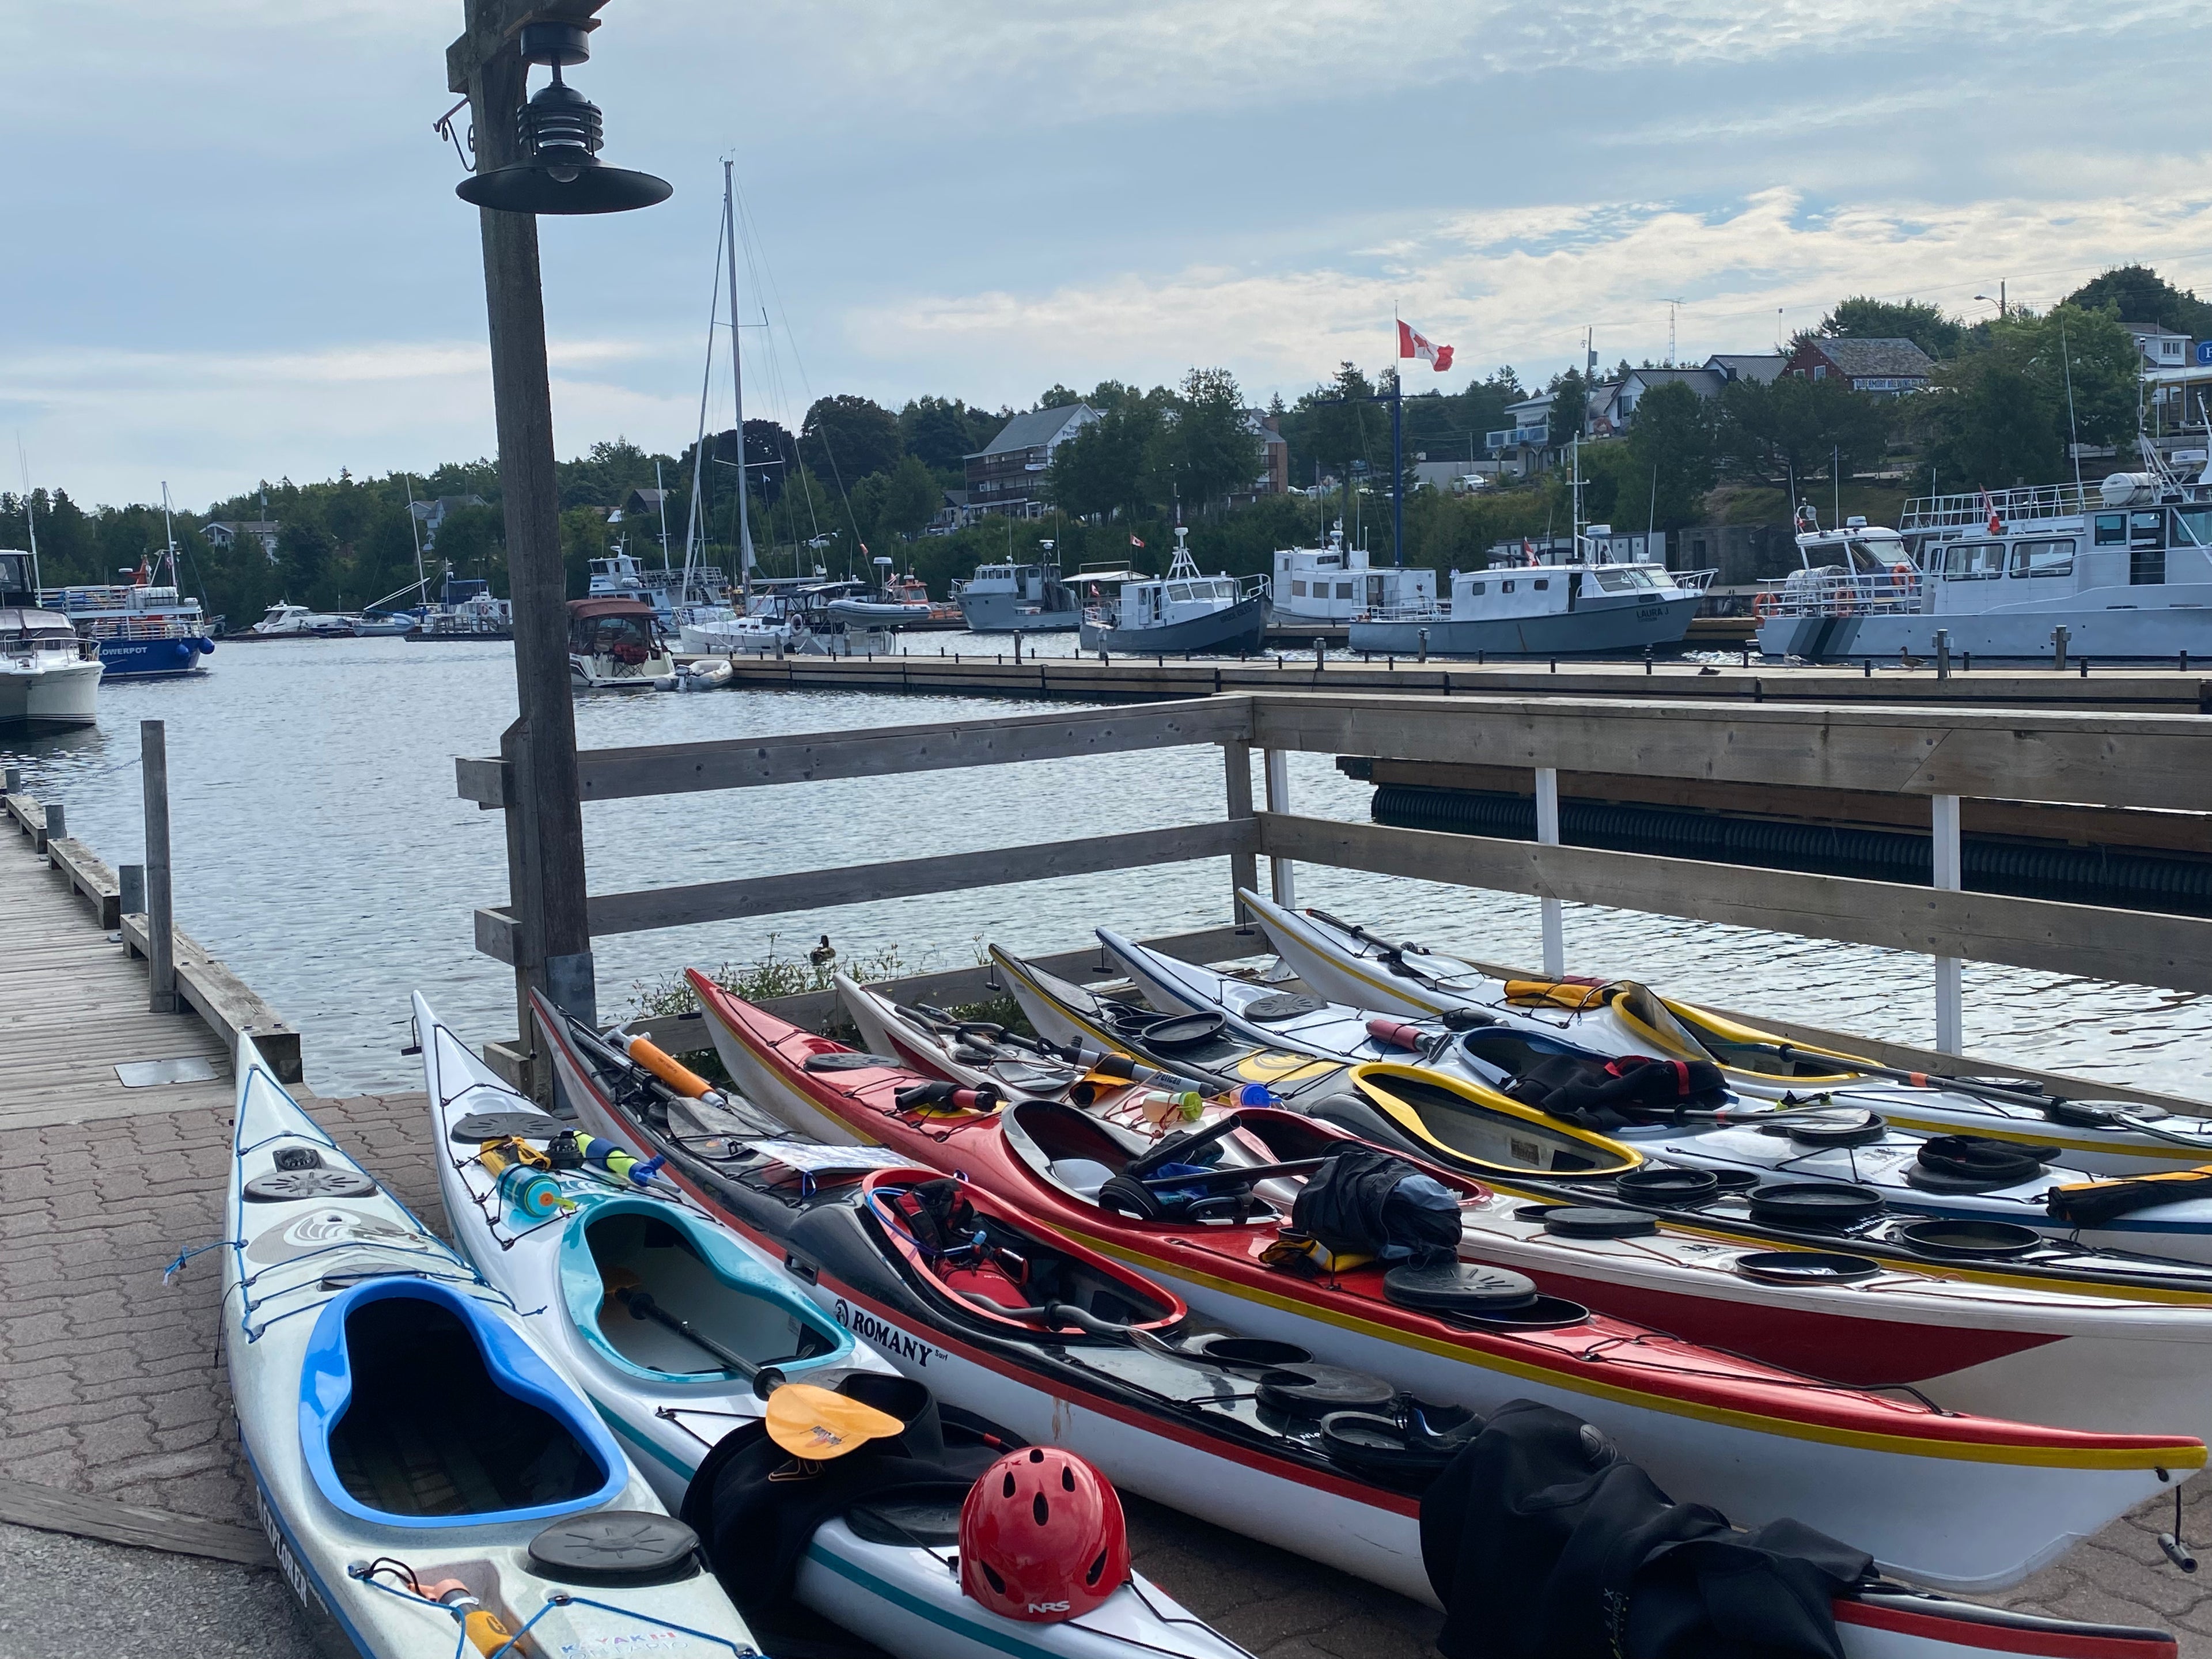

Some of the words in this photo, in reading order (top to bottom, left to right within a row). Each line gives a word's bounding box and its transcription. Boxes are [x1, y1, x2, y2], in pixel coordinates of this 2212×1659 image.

[1637, 608, 1663, 618] LAURA
[1665, 607, 1669, 615] J
[99, 647, 147, 656] OWERPOT
[1155, 1073, 1181, 1085] Pelican
[853, 1310, 933, 1368] ROMANY
[935, 1349, 948, 1361] Surf
[263, 1503, 308, 1608] EXPLORER
[1028, 1600, 1070, 1613] NRS
[562, 1634, 646, 1653] KYAK
